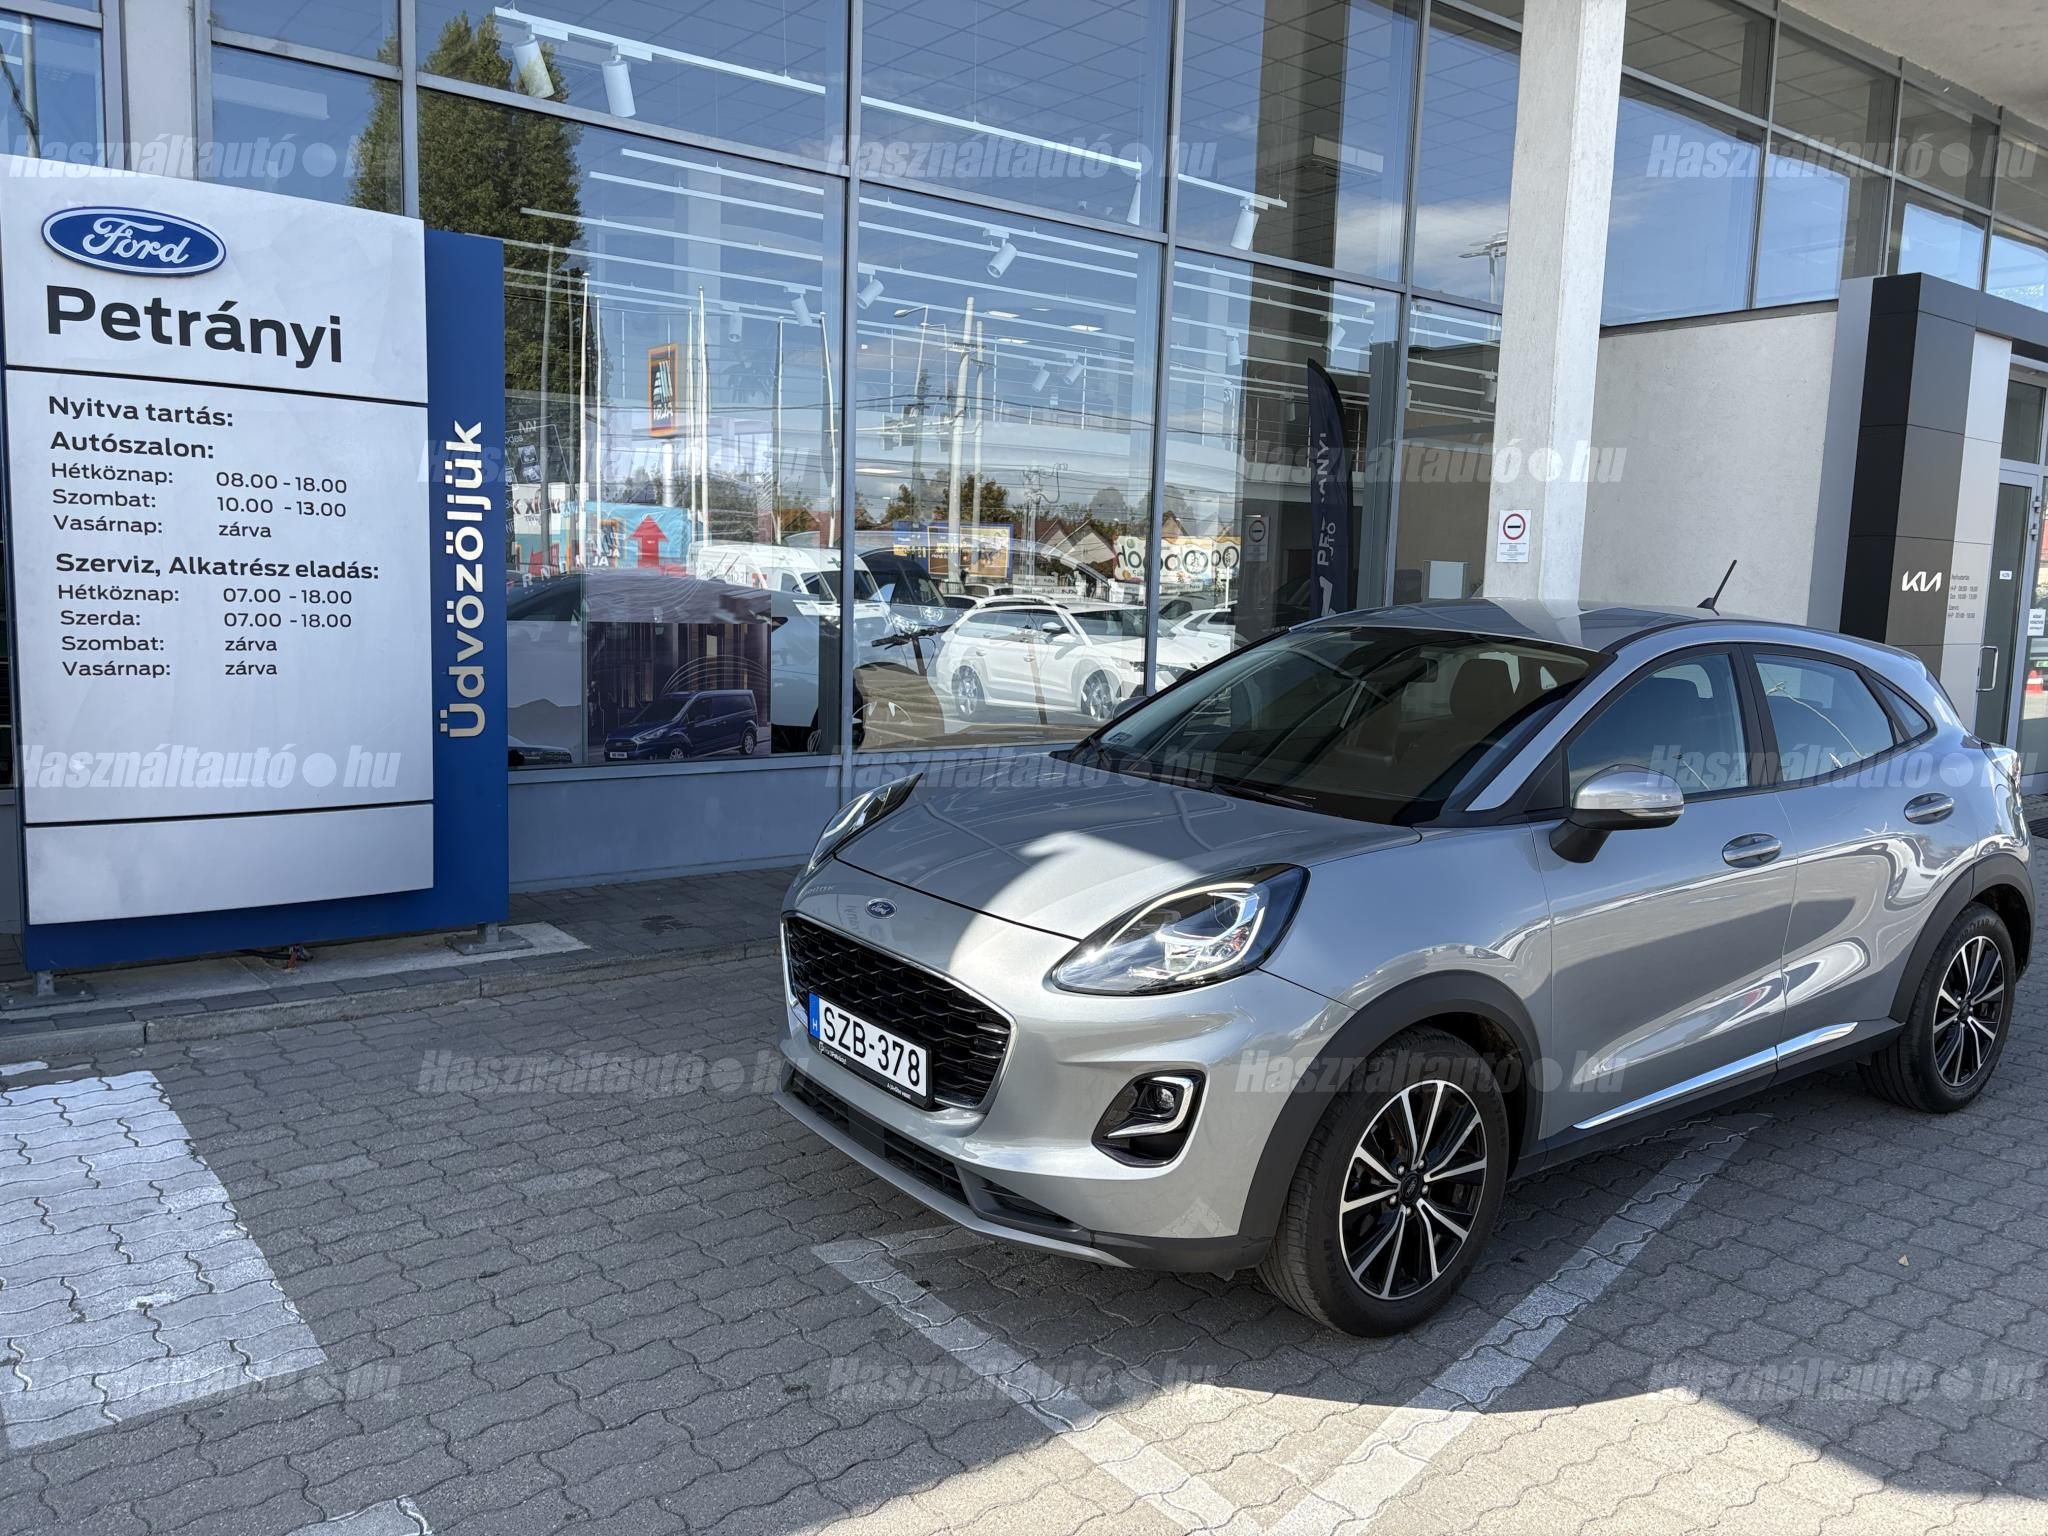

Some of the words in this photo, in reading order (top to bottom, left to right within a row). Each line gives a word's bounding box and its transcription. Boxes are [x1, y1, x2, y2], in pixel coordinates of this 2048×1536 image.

[82, 217, 190, 264] Ford
[46, 285, 342, 369] Petrányi
[49, 396, 139, 419] Nyitva
[146, 404, 232, 426] tartás:
[51, 432, 213, 458] Autószalon:
[52, 463, 172, 485] Hétköznap:
[217, 472, 277, 489] 08.00
[53, 489, 155, 507] Szombat:
[218, 497, 273, 513] 10.00
[54, 515, 162, 535] Vasárnap:
[219, 522, 271, 537] zárva
[56, 554, 160, 577] Szerviz,
[169, 557, 290, 576] Alkatrész
[296, 561, 378, 579] eladás:
[440, 420, 491, 738] Üdvözöljük
[59, 585, 178, 603] Hétköznap:
[224, 588, 280, 602] 07.00
[1902, 571, 1942, 592] KIA
[61, 610, 140, 625] Szerda:
[225, 613, 281, 627] 07.00
[62, 636, 163, 650] Szombat:
[225, 637, 277, 651] zárva
[62, 661, 170, 678] Vasárnap:
[226, 661, 277, 675] zárva
[812, 1018, 818, 1032] H
[824, 1006, 920, 1087] SZB-378
